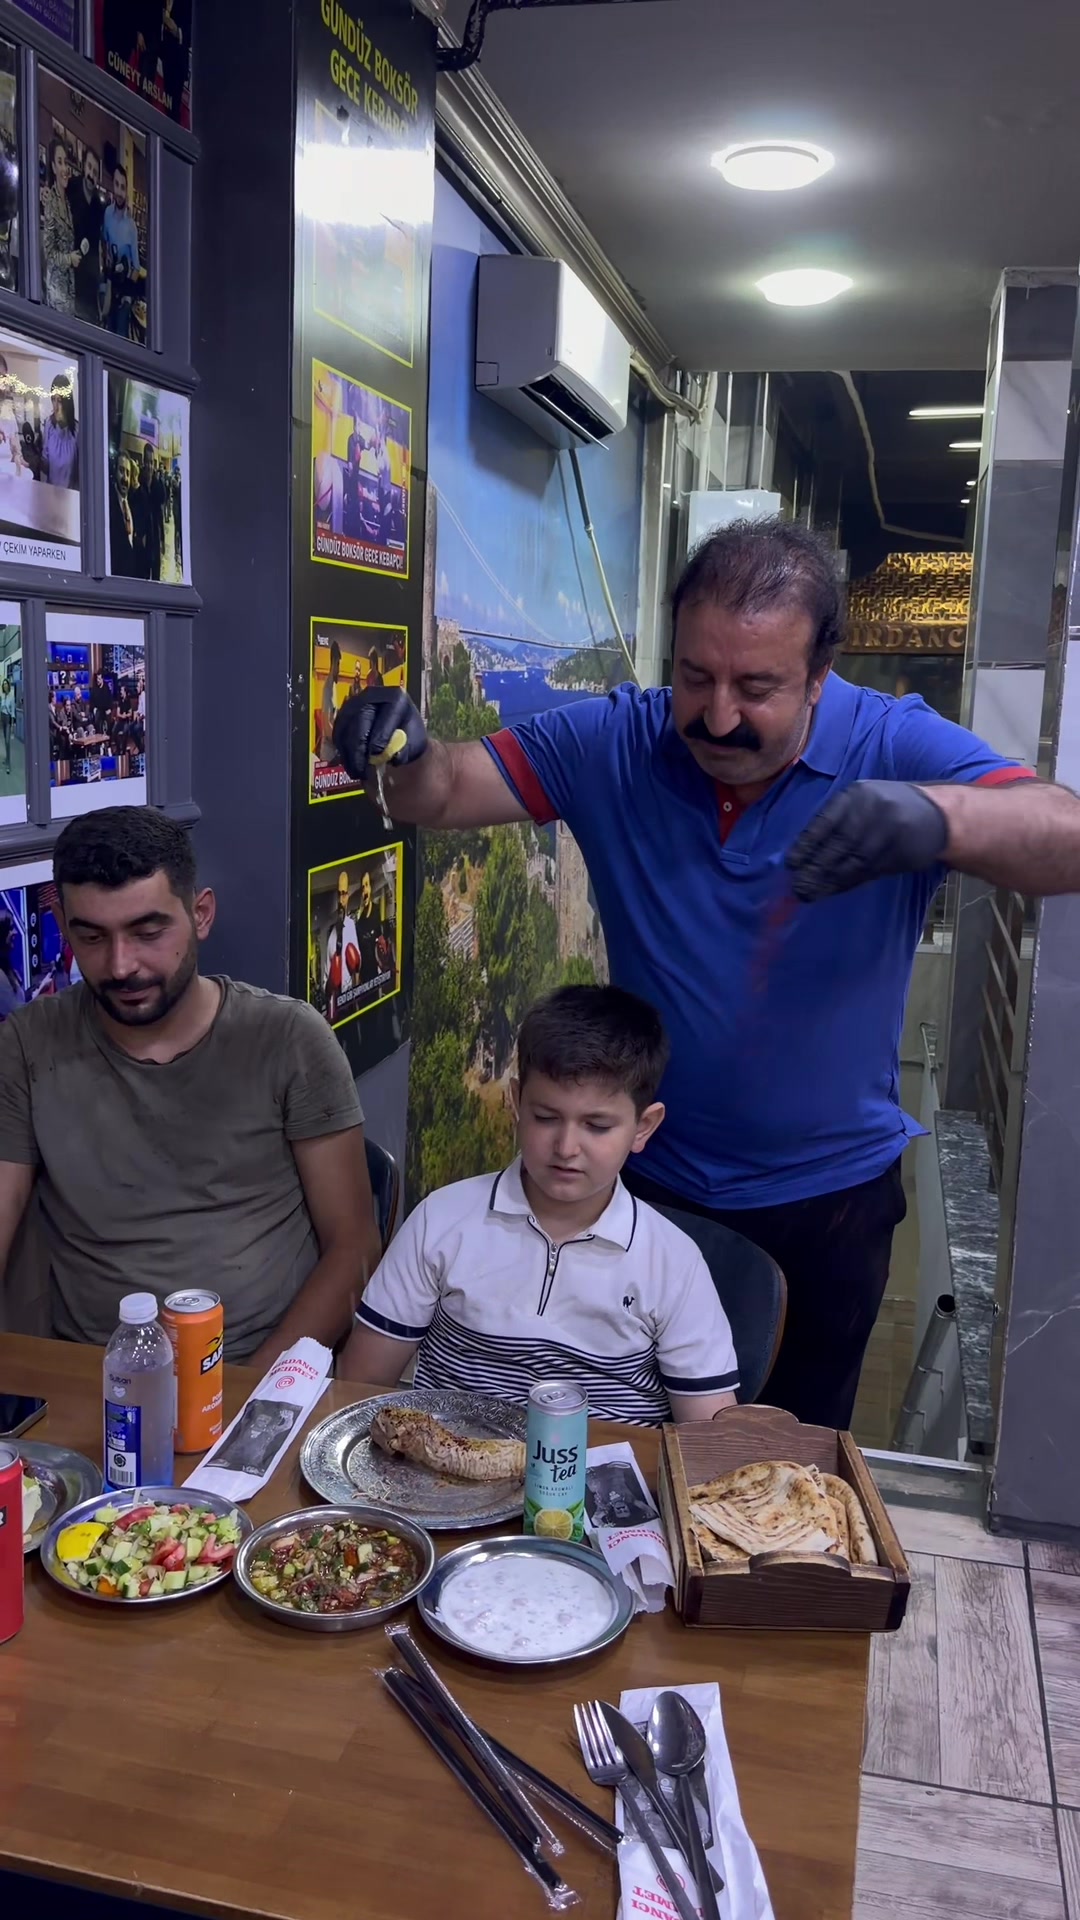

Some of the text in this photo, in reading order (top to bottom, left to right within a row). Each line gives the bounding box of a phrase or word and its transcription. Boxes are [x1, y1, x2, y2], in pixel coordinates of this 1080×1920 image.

[108, 50, 173, 111] CÜNEYT ARSLAN
[330, 48, 360, 106] GECE
[375, 47, 418, 120] BOKSÖR
[3, 541, 67, 560] ÇEKİM YAPARKEN
[316, 533, 341, 556] GÜNDÜZ
[341, 541, 364, 560] BOKSÖR
[364, 547, 379, 564] GECE
[851, 627, 965, 648] IRDANC
[315, 769, 339, 789] GÜNDÜZ
[532, 1440, 578, 1464] Juss
[549, 1464, 577, 1483] tea
